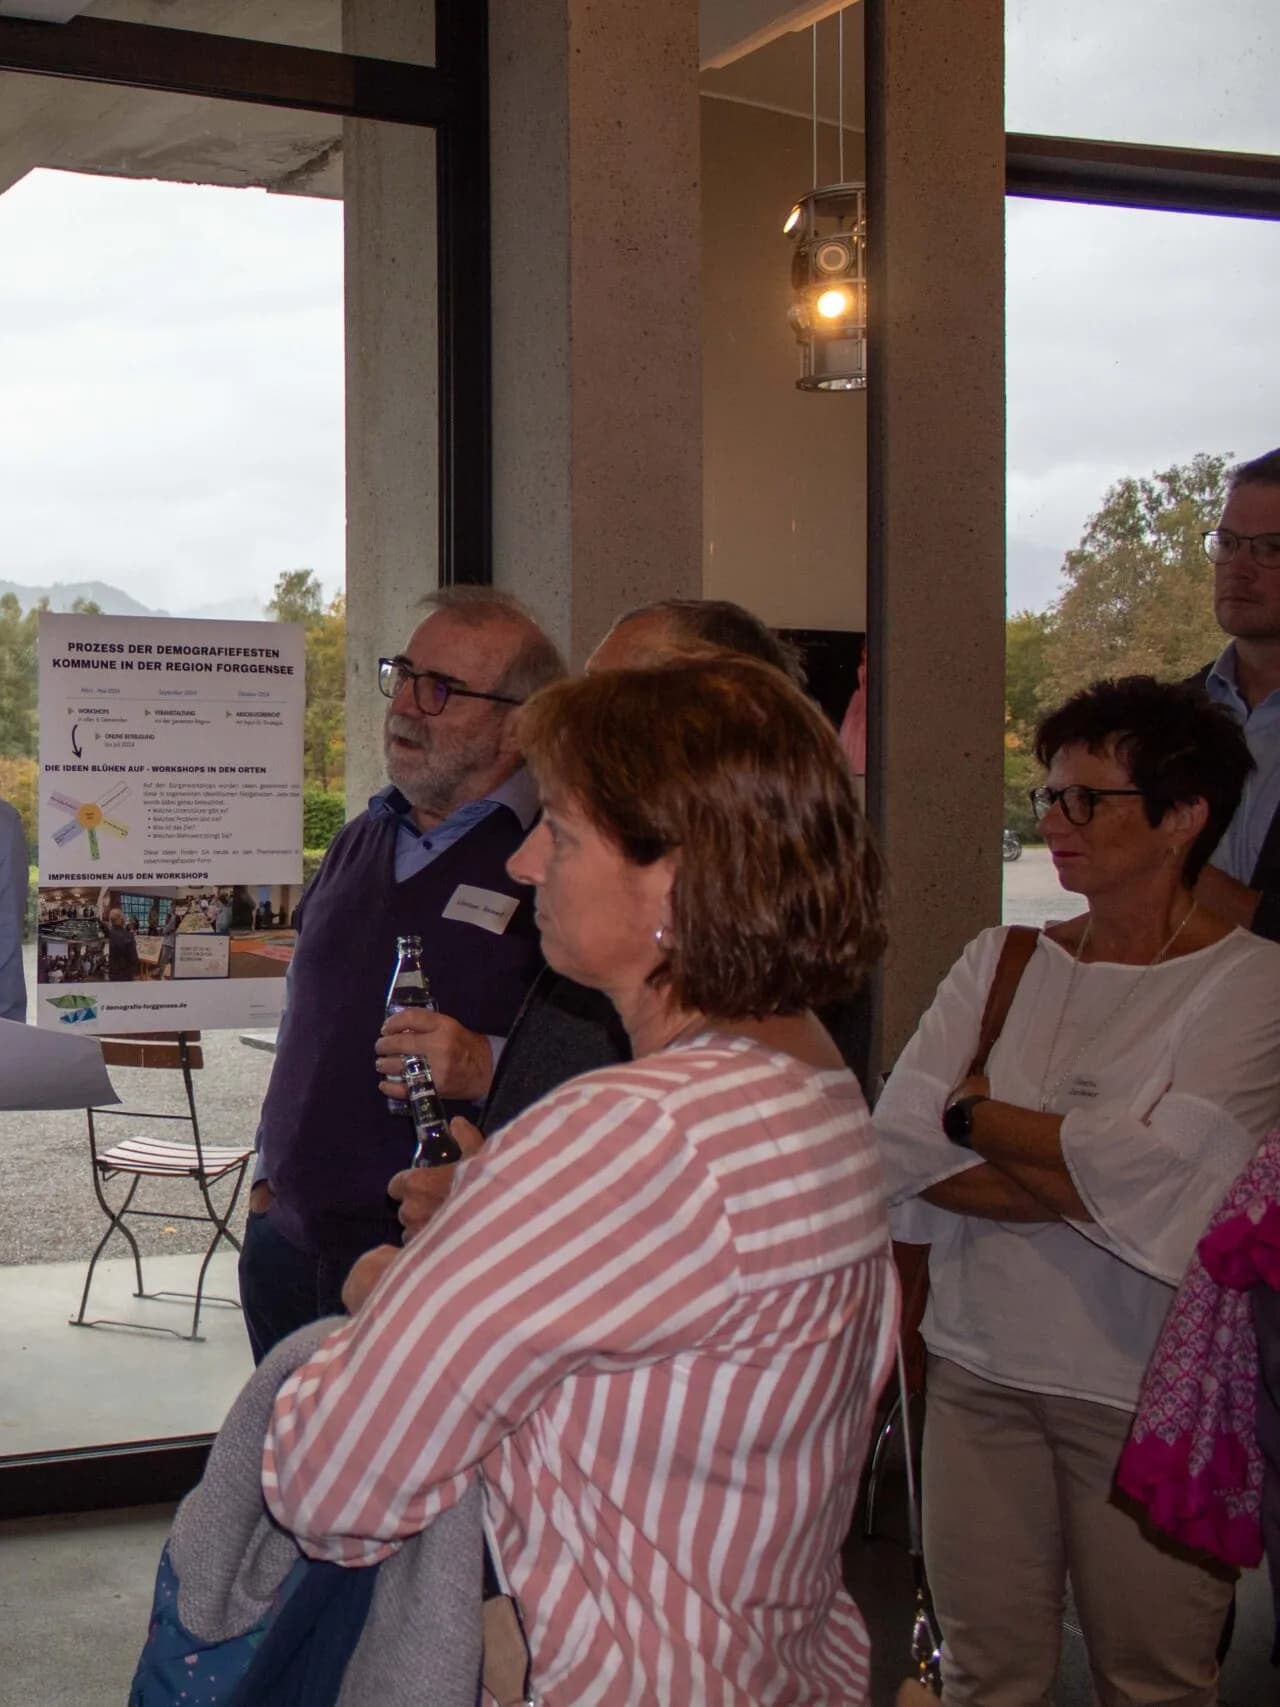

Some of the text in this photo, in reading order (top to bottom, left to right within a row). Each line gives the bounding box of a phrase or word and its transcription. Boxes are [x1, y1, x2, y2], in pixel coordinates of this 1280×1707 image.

[67, 642, 280, 658] PROZESS DER DEMOGRAFIEFESTEN
[52, 658, 294, 675] KOMMUNE IN DER REGION FORGGENSEE
[44, 764, 60, 773] DIE
[62, 764, 88, 773] IDEEN
[91, 763, 126, 773] BLÜHEN
[128, 765, 145, 773] AUF
[152, 765, 205, 774] WORKSHOPS
[207, 766, 217, 774] IN
[218, 766, 236, 774] DEN
[238, 766, 267, 774] ORTEN
[48, 873, 114, 881] IMPRESSIONEN
[136, 872, 153, 880] DEN
[155, 872, 209, 880] WORKSHOPS
